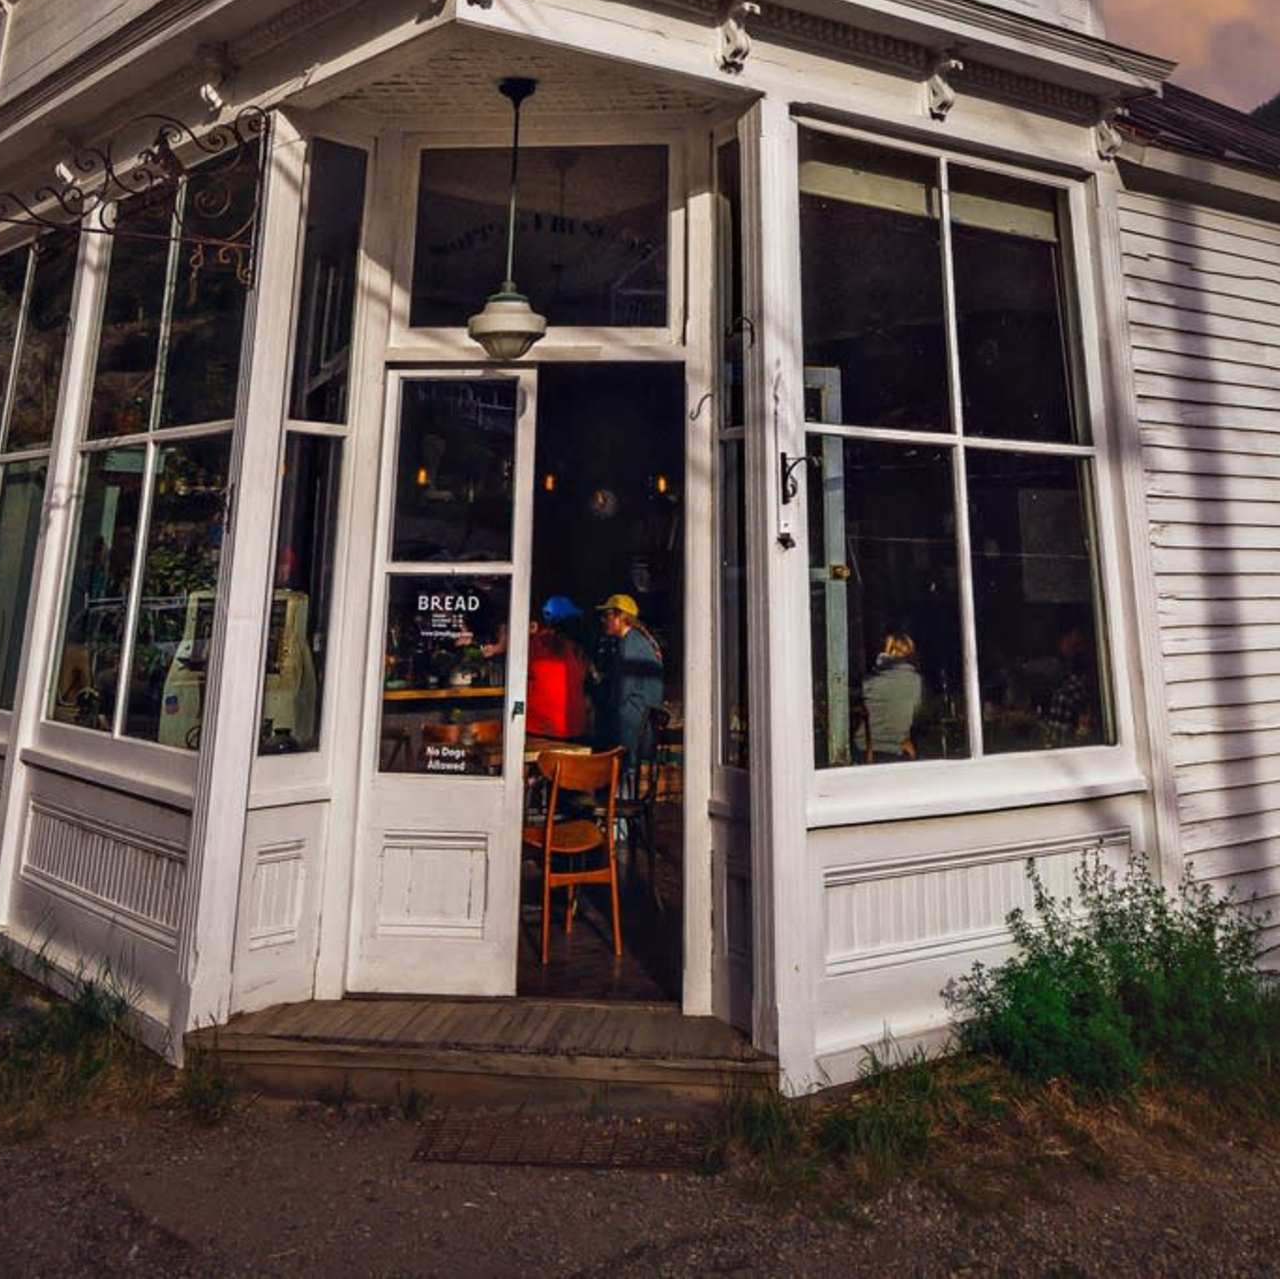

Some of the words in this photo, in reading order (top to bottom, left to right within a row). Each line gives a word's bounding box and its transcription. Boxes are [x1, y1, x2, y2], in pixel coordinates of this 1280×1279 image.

[418, 595, 480, 611] BREAD
[426, 746, 440, 755] No
[442, 747, 465, 759] Dogs
[427, 760, 465, 770] Allowed
